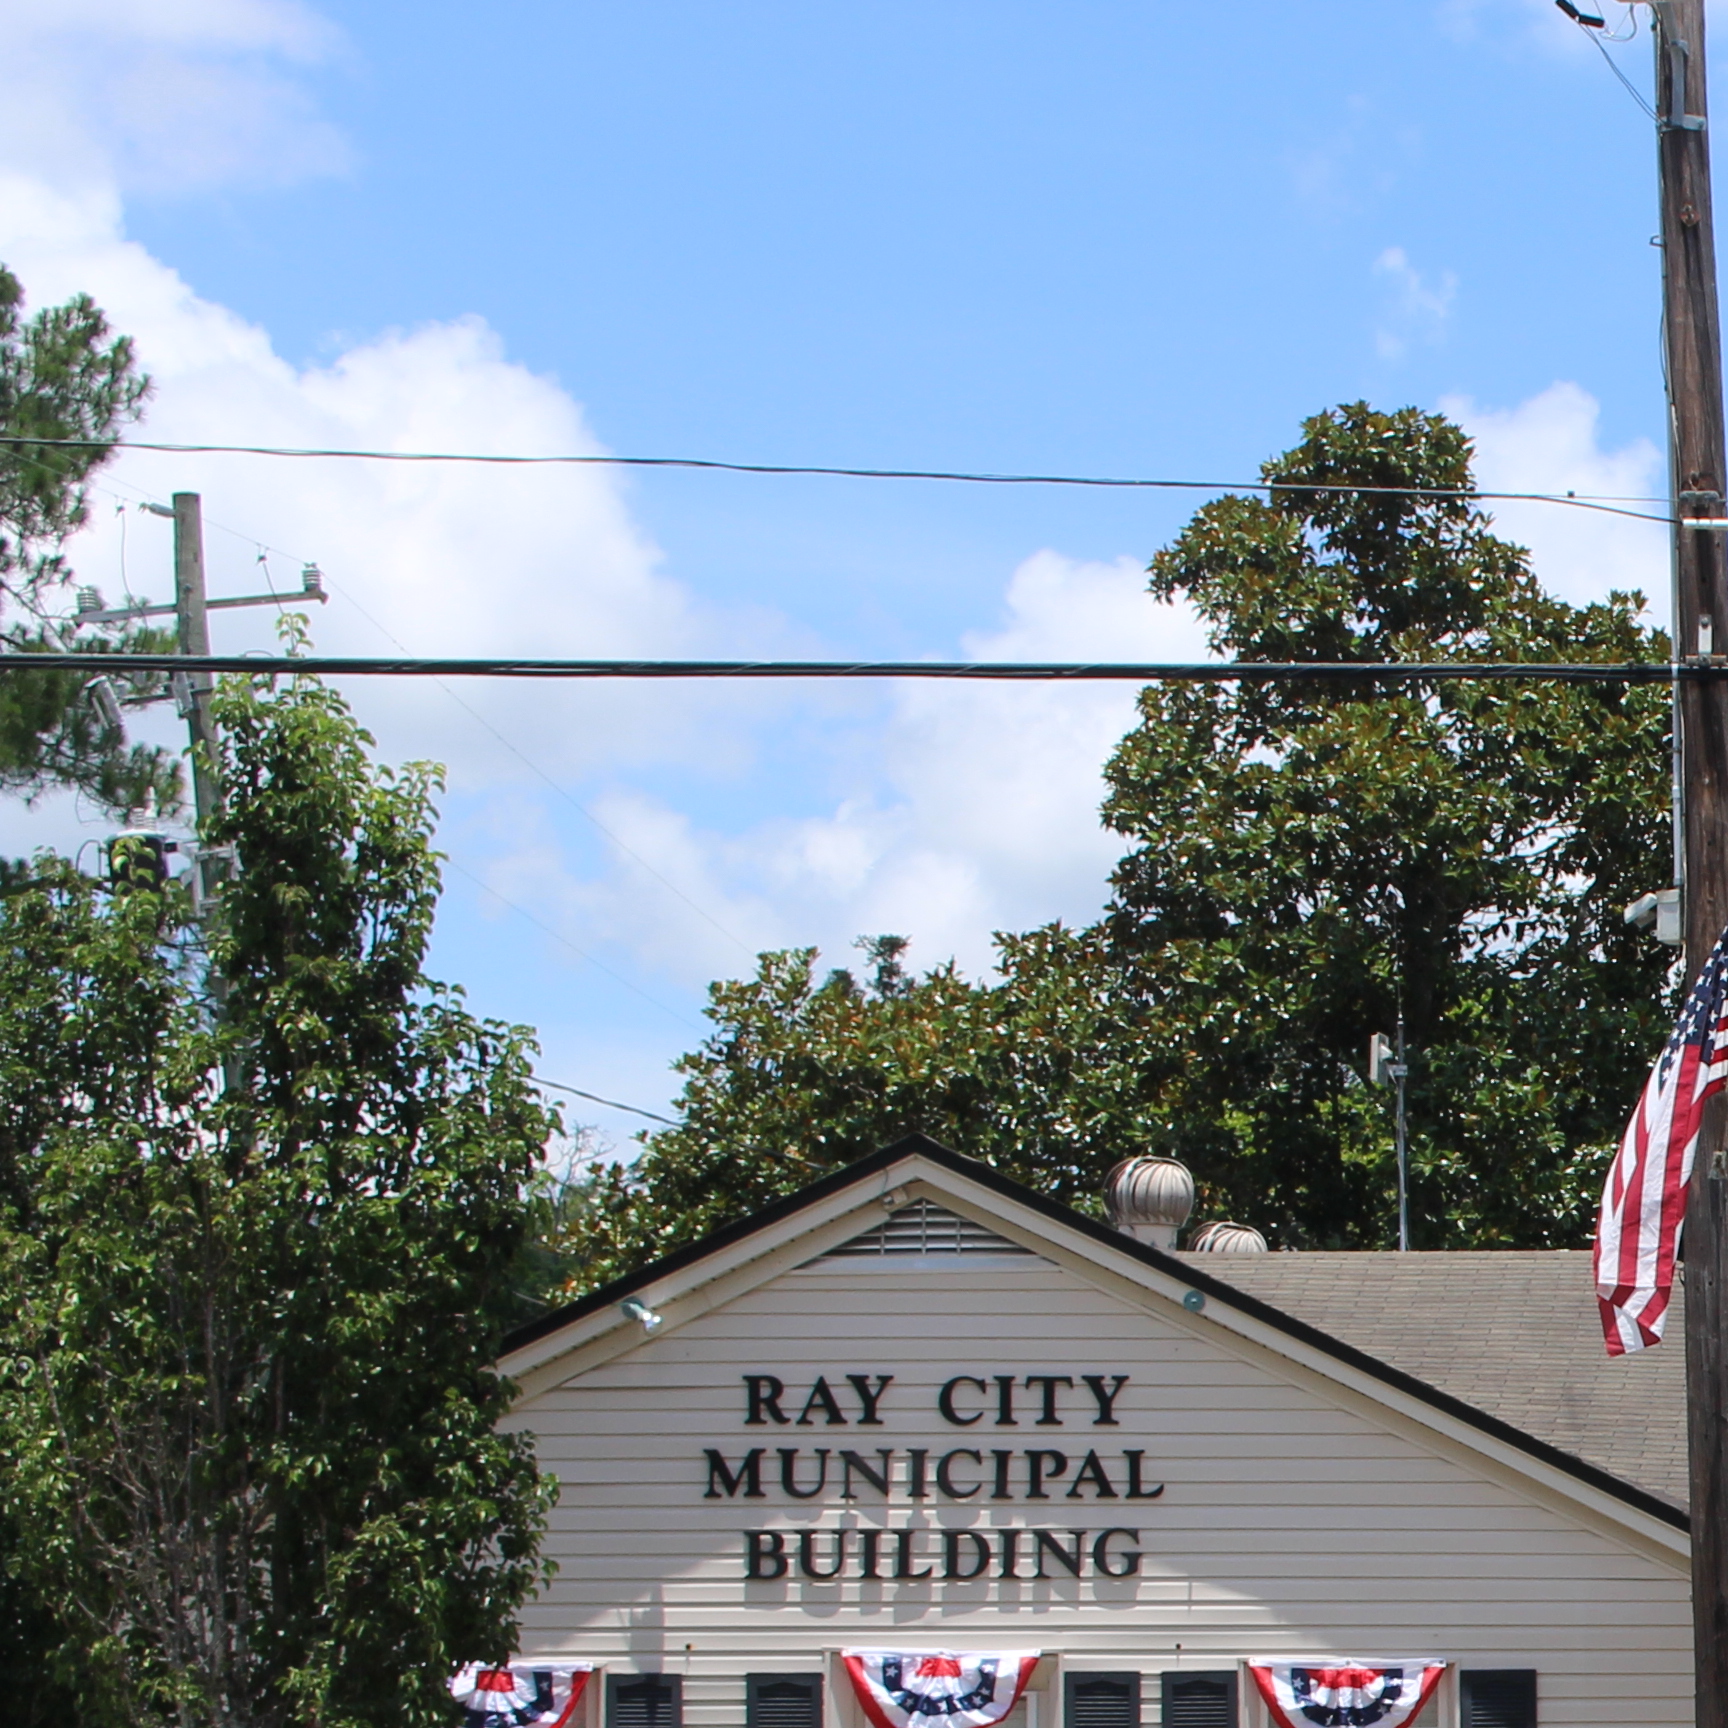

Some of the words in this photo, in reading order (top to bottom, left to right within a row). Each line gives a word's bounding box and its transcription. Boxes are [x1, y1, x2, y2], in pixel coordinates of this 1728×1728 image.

[742, 1374, 894, 1426] RAY
[938, 1374, 1130, 1426] CITY
[703, 1448, 1165, 1500] MUNICIPAL
[744, 1527, 1144, 1580] BUILDING
